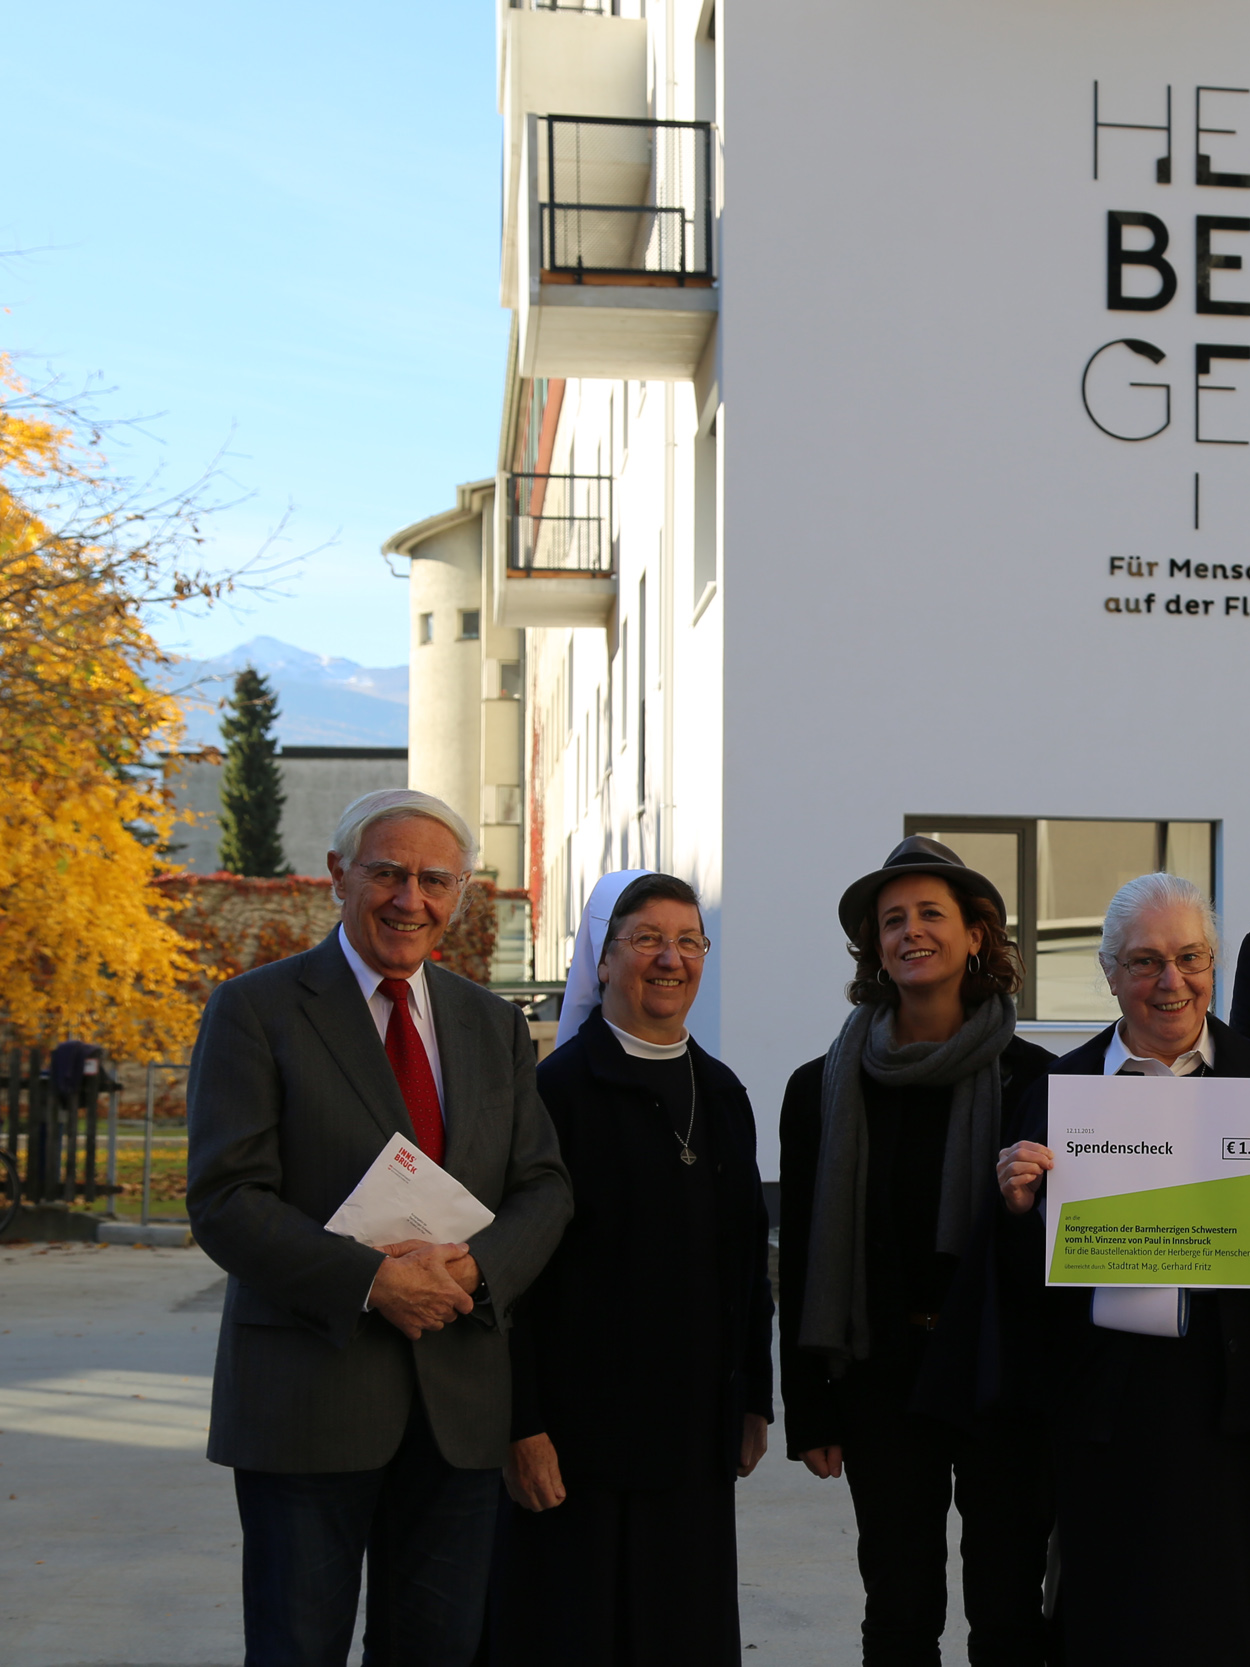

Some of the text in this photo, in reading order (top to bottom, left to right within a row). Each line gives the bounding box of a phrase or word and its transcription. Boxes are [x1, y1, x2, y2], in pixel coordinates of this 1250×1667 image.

[1108, 555, 1159, 578] Für
[1104, 594, 1156, 614] auf
[1165, 595, 1214, 616] der
[1066, 1141, 1173, 1156] Spendenscheck
[394, 1154, 417, 1174] BRUCK
[1065, 1224, 1237, 1235] Kongregation der Barmherzigen Schwestern
[1084, 1236, 1093, 1244] hl.
[1095, 1236, 1126, 1245] Vinzenz
[1144, 1236, 1162, 1245] Paul
[1163, 1236, 1170, 1245] in
[1172, 1236, 1211, 1245] Innsbruck
[1078, 1247, 1089, 1255] die
[1091, 1247, 1152, 1256] Baustellenaktion
[1154, 1248, 1166, 1256] der
[1167, 1248, 1201, 1259] Herberge
[1202, 1248, 1213, 1257] für
[1108, 1262, 1139, 1271] Stadtrat
[1142, 1262, 1159, 1272] Mag.
[1161, 1262, 1192, 1271] Gerhard
[1194, 1262, 1212, 1271] Fritz
